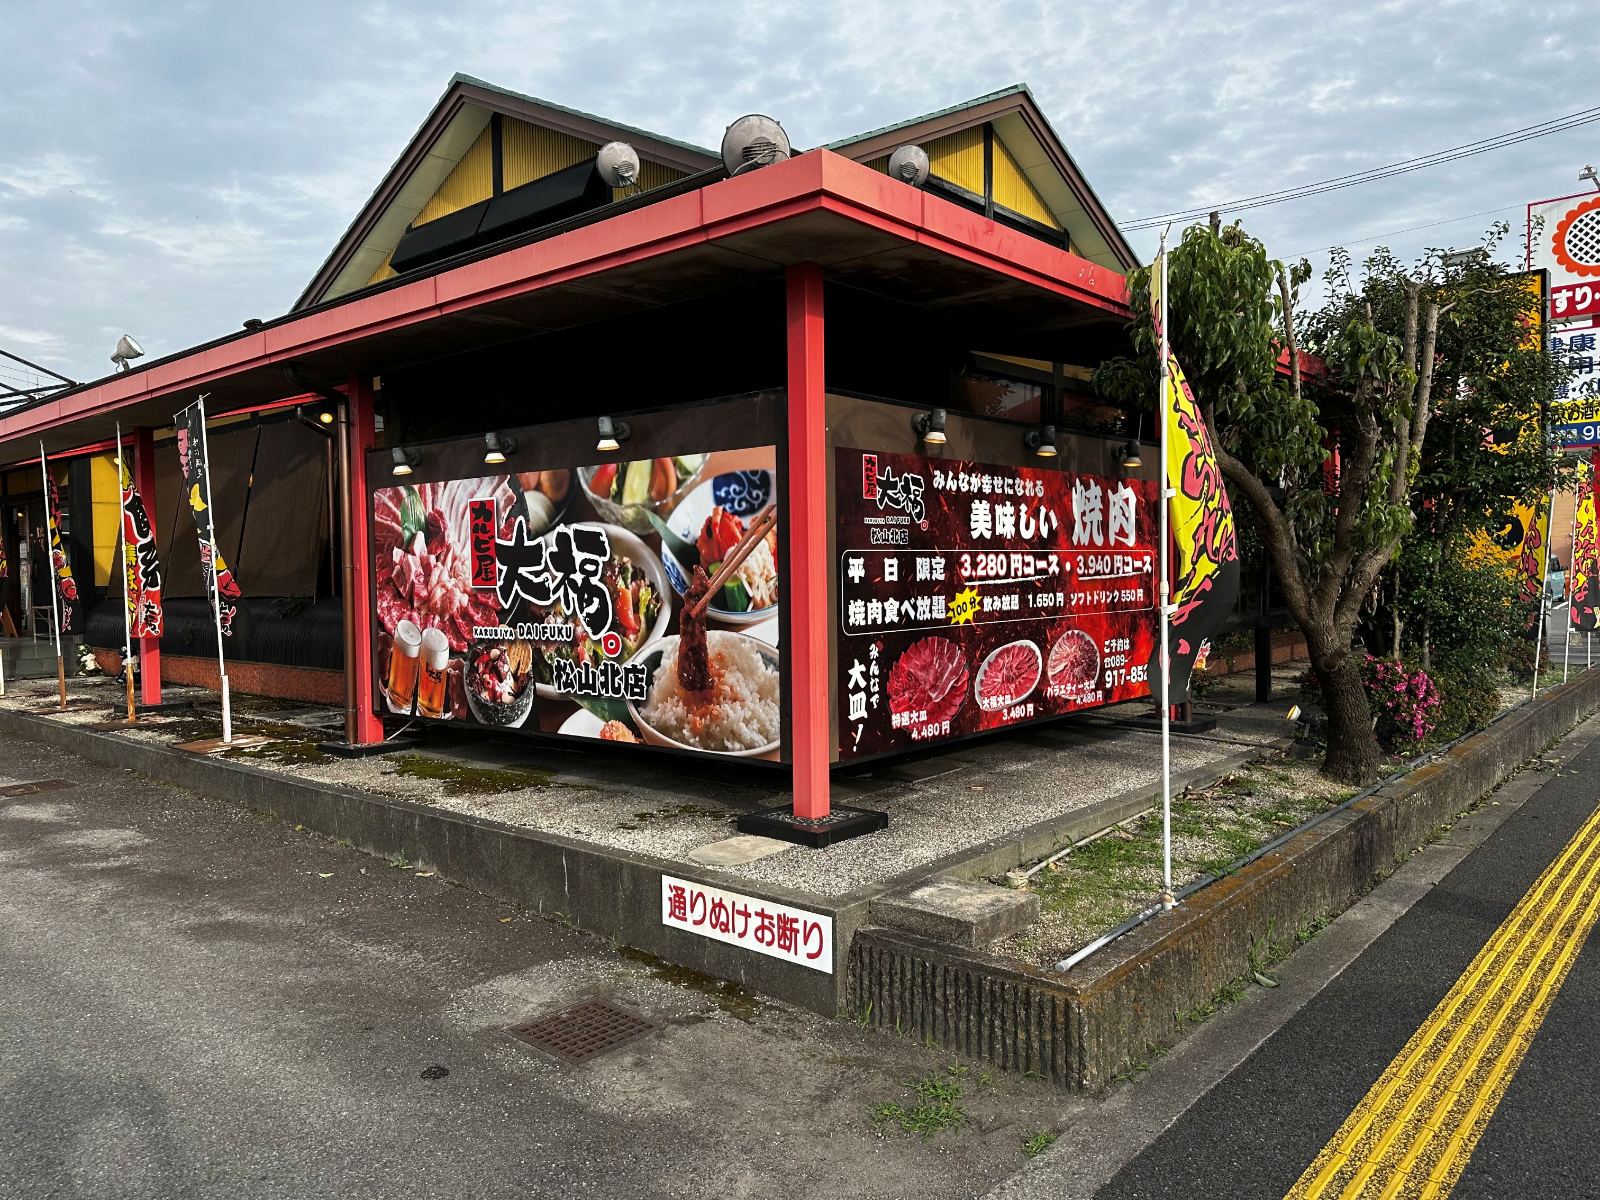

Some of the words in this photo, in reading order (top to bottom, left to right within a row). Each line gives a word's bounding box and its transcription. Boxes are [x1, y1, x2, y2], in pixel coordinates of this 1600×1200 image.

[876, 465, 926, 524] 大福
[932, 470, 1045, 498] みんなが幸せになれる
[970, 499, 1059, 541] 美味しい
[1071, 477, 1138, 547] 焼肉
[471, 500, 496, 585] カルビ屋
[871, 528, 909, 545] 松山北店
[495, 515, 613, 641] 大福
[848, 593, 946, 627] 焼肉食べ放題
[982, 594, 1020, 613] 飲み放題
[473, 625, 515, 640] KARUBIYA
[517, 622, 574, 642] DAIFUKU
[1104, 637, 1130, 653] ご予約は
[553, 658, 647, 700] 松山北店
[869, 643, 880, 709] みんなで
[667, 883, 824, 960] 通りぬけお断り
